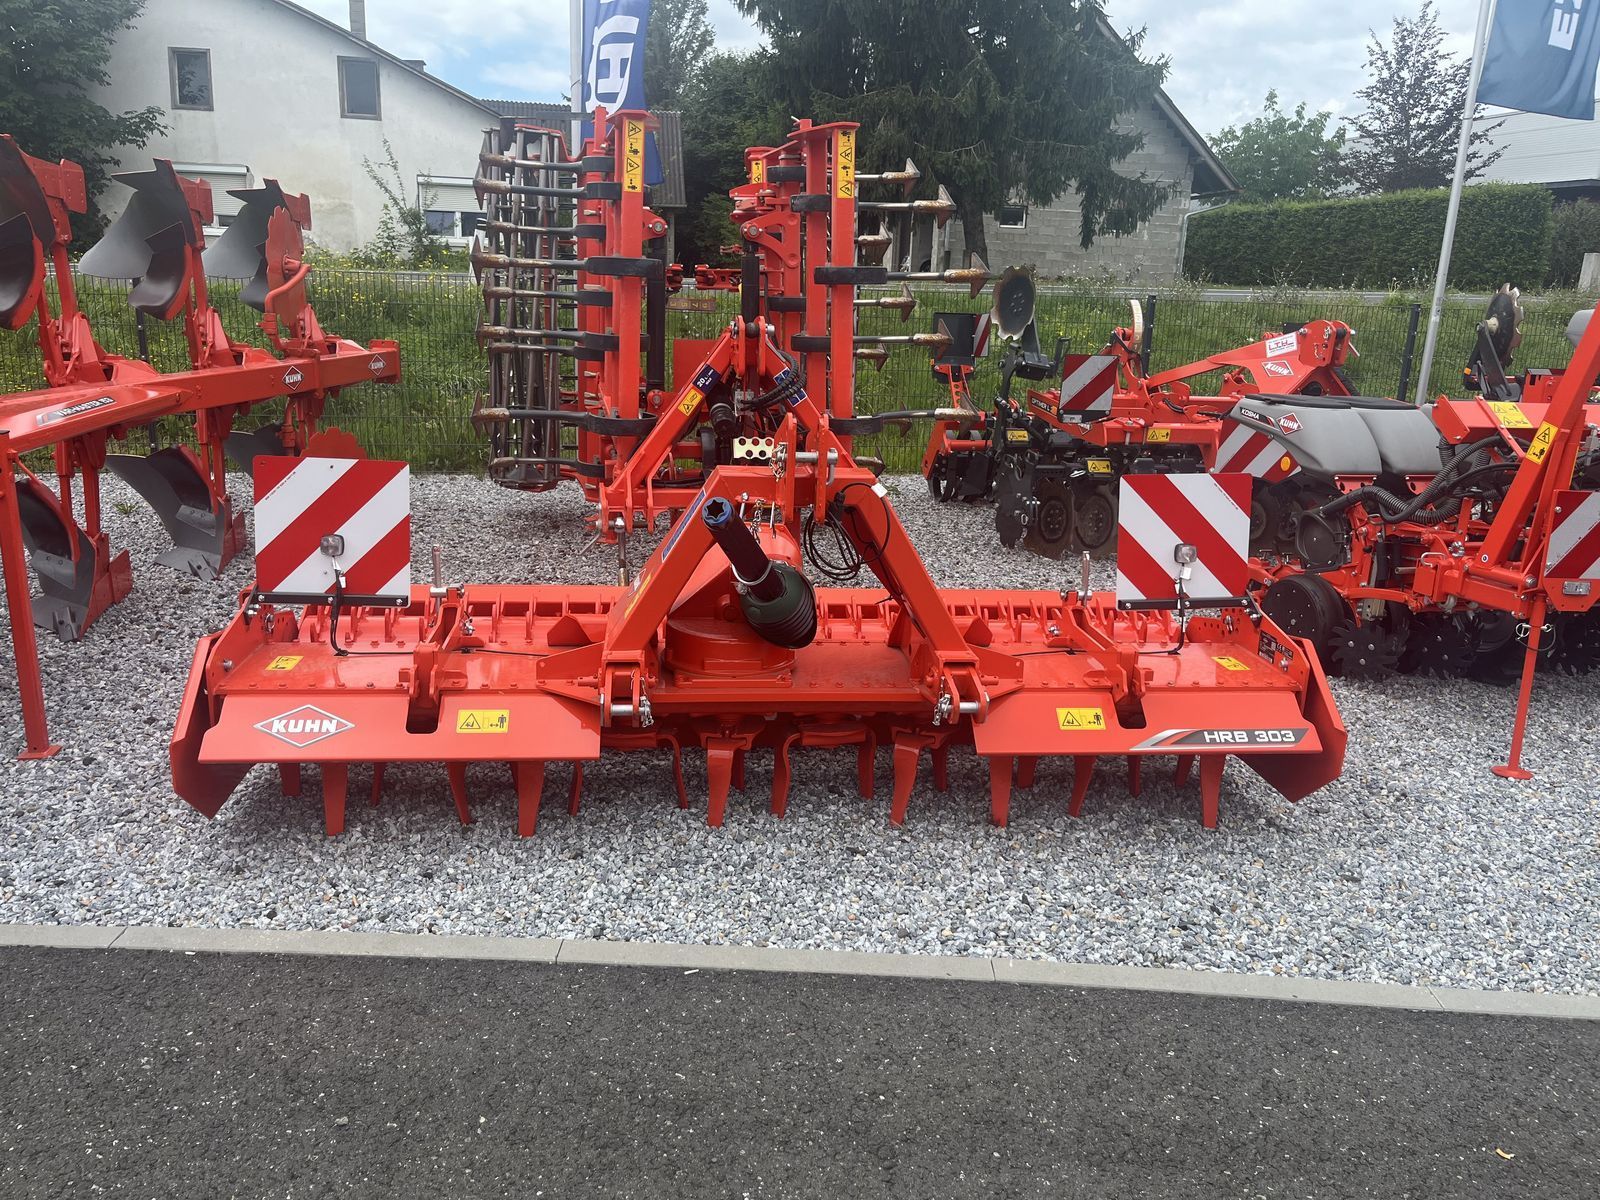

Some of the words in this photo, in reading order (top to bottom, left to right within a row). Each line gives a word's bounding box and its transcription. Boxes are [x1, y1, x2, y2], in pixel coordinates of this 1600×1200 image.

[1265, 362, 1290, 375] KUHN
[285, 373, 302, 384] KUHN
[1241, 408, 1260, 420] KOSMA
[1279, 417, 1299, 430] KUHN
[271, 719, 338, 733] KUHN
[1203, 730, 1248, 743] HRB
[1254, 730, 1295, 742] 303
